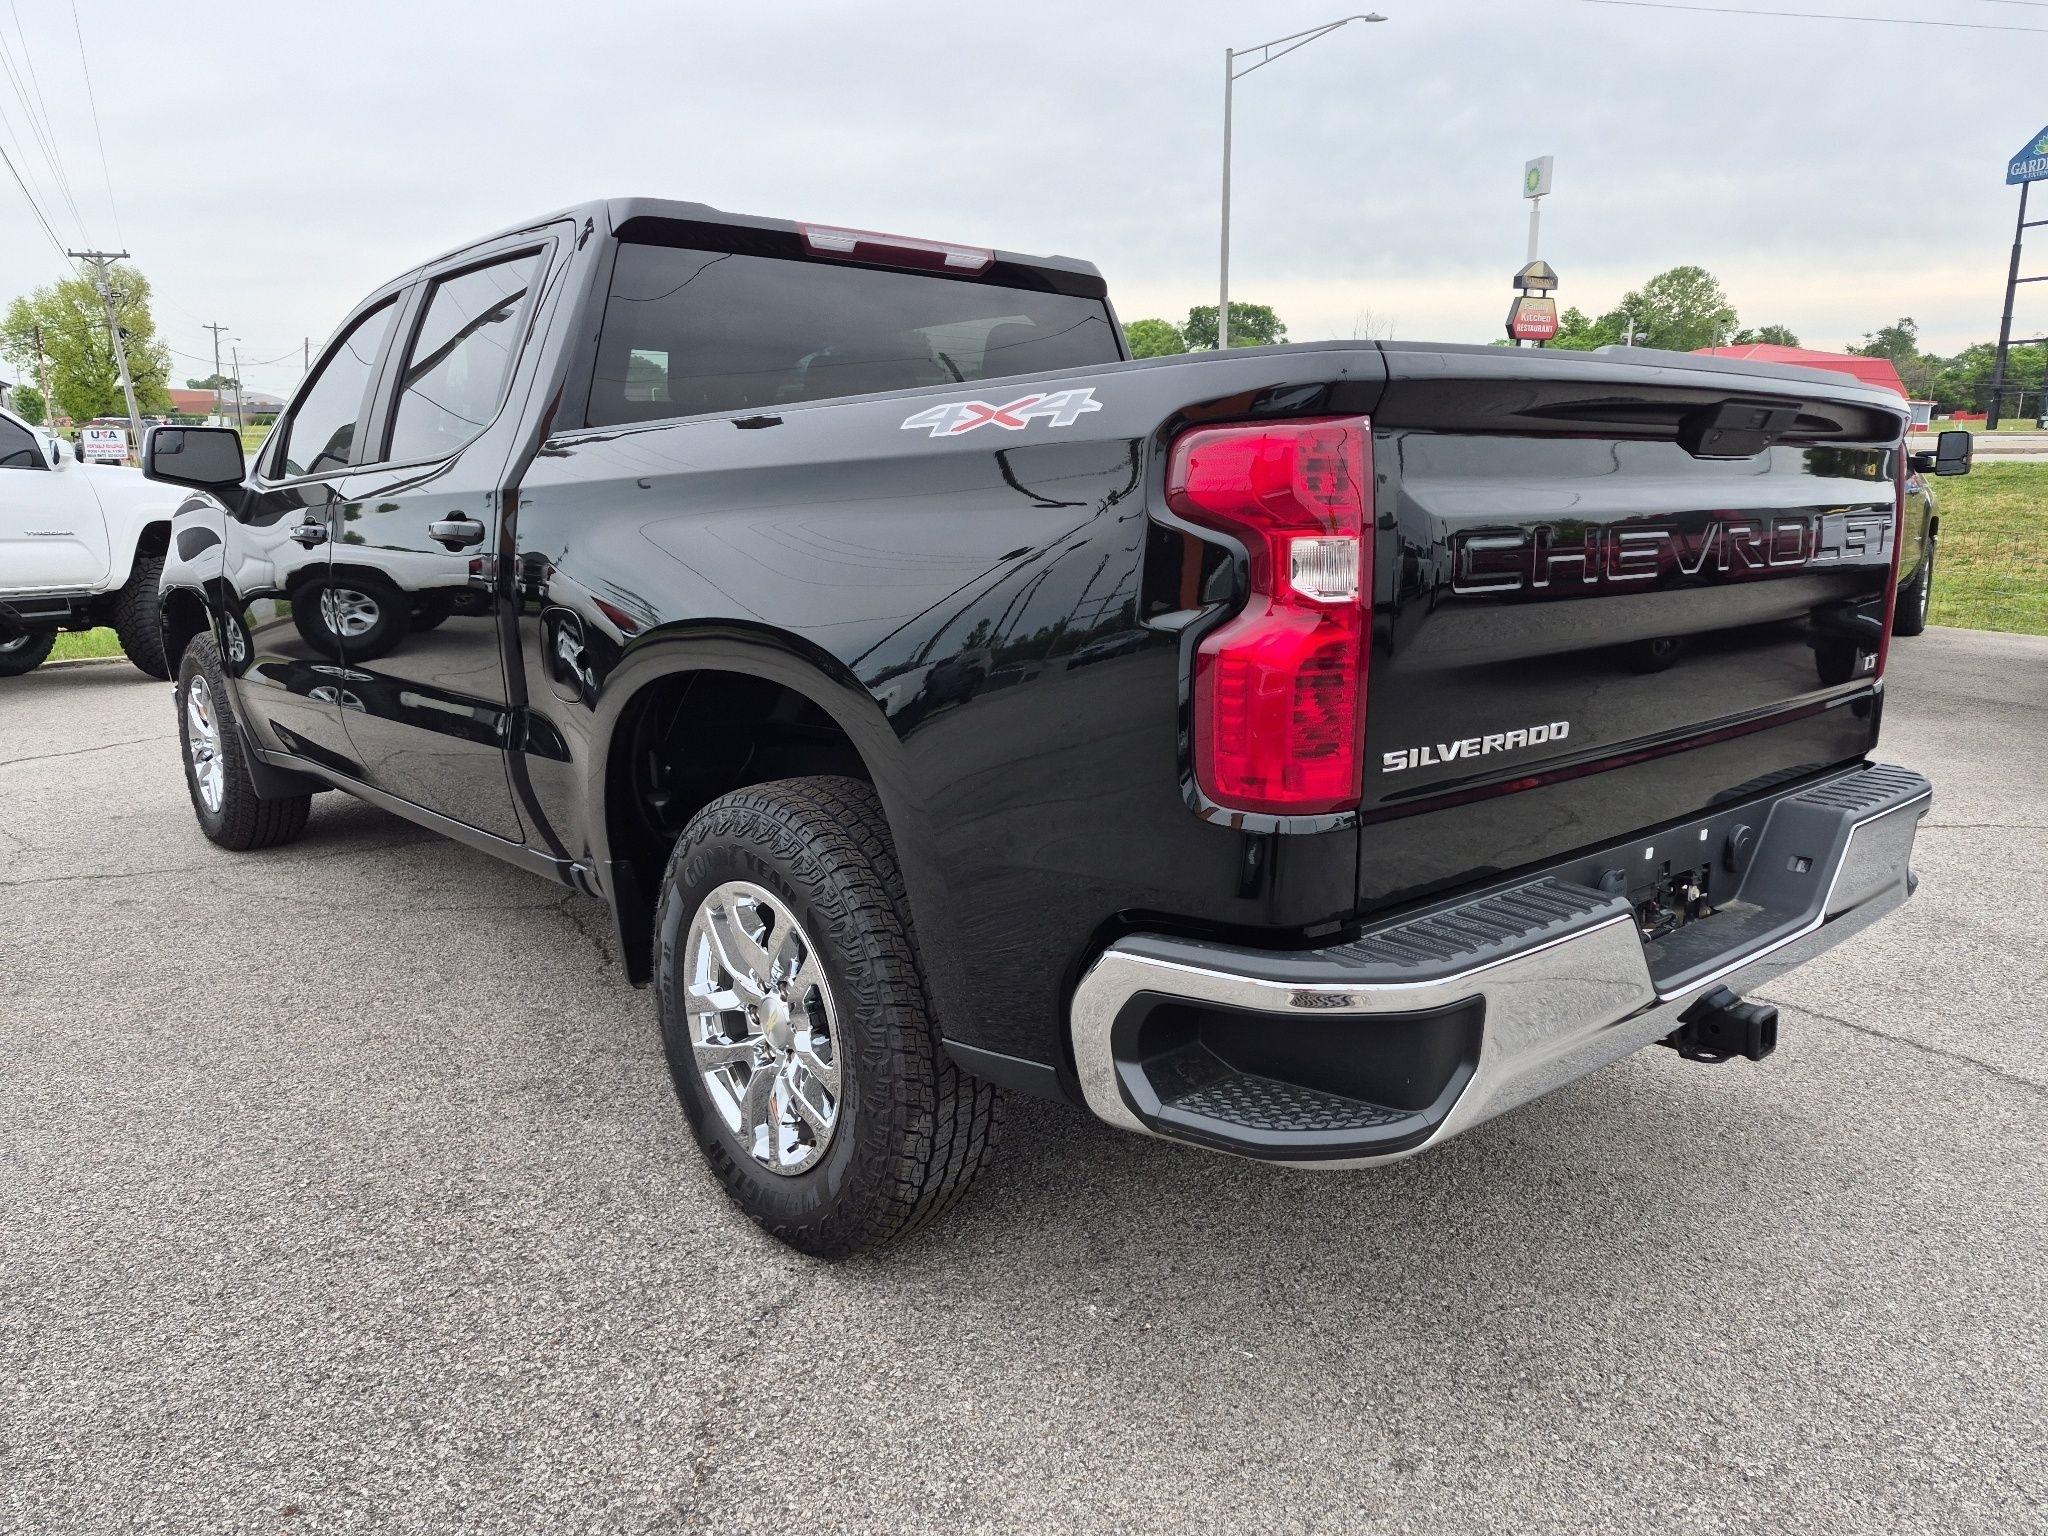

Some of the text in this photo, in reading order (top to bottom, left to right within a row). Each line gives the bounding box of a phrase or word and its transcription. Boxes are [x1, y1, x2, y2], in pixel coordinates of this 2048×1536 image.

[1516, 323, 1553, 332] RESTAURANT
[1521, 312, 1551, 322] Kitchen
[1452, 512, 1893, 594] CHEVROLET
[1382, 721, 1569, 773] SILVERADO
